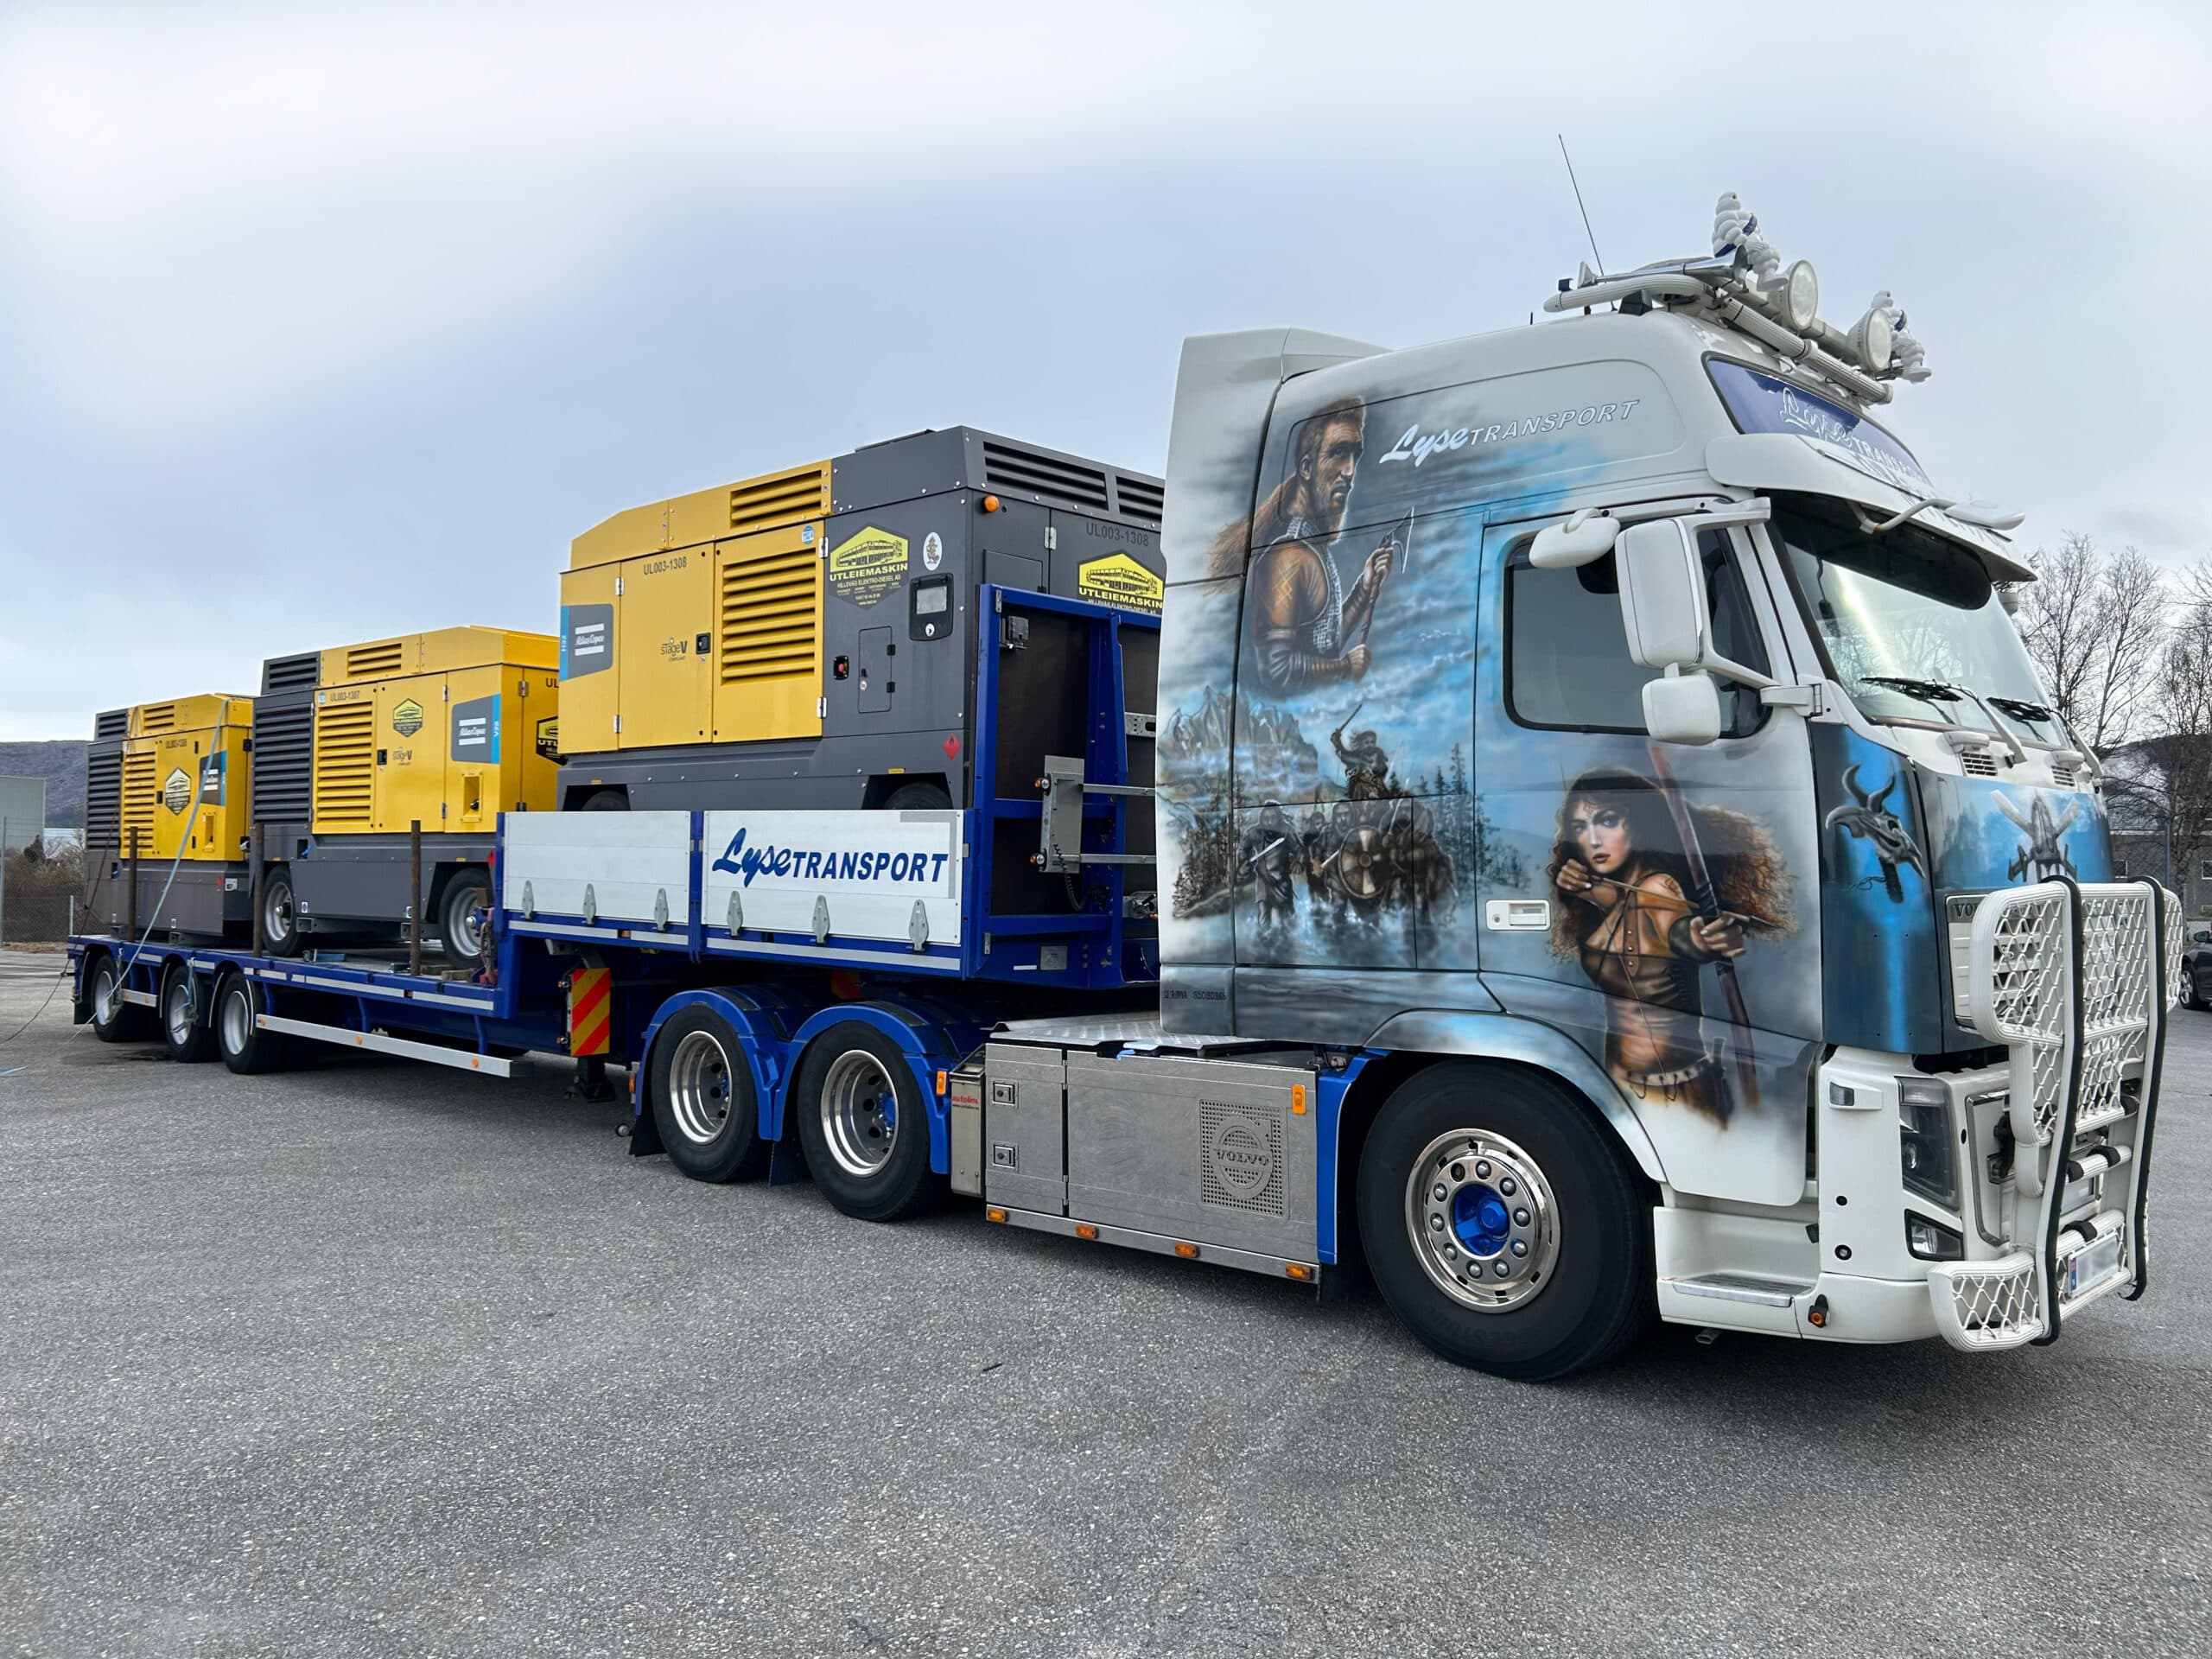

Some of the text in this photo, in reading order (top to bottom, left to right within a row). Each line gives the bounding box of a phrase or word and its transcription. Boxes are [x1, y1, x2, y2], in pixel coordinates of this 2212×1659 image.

[1086, 522, 1149, 546] UL003-1308
[644, 556, 688, 575] UL003-1308
[830, 563, 908, 582] UTLEIEMASKIN
[1078, 587, 1163, 609] UTLEIEMASKIN
[1213, 1148, 1269, 1166] VOLVO
